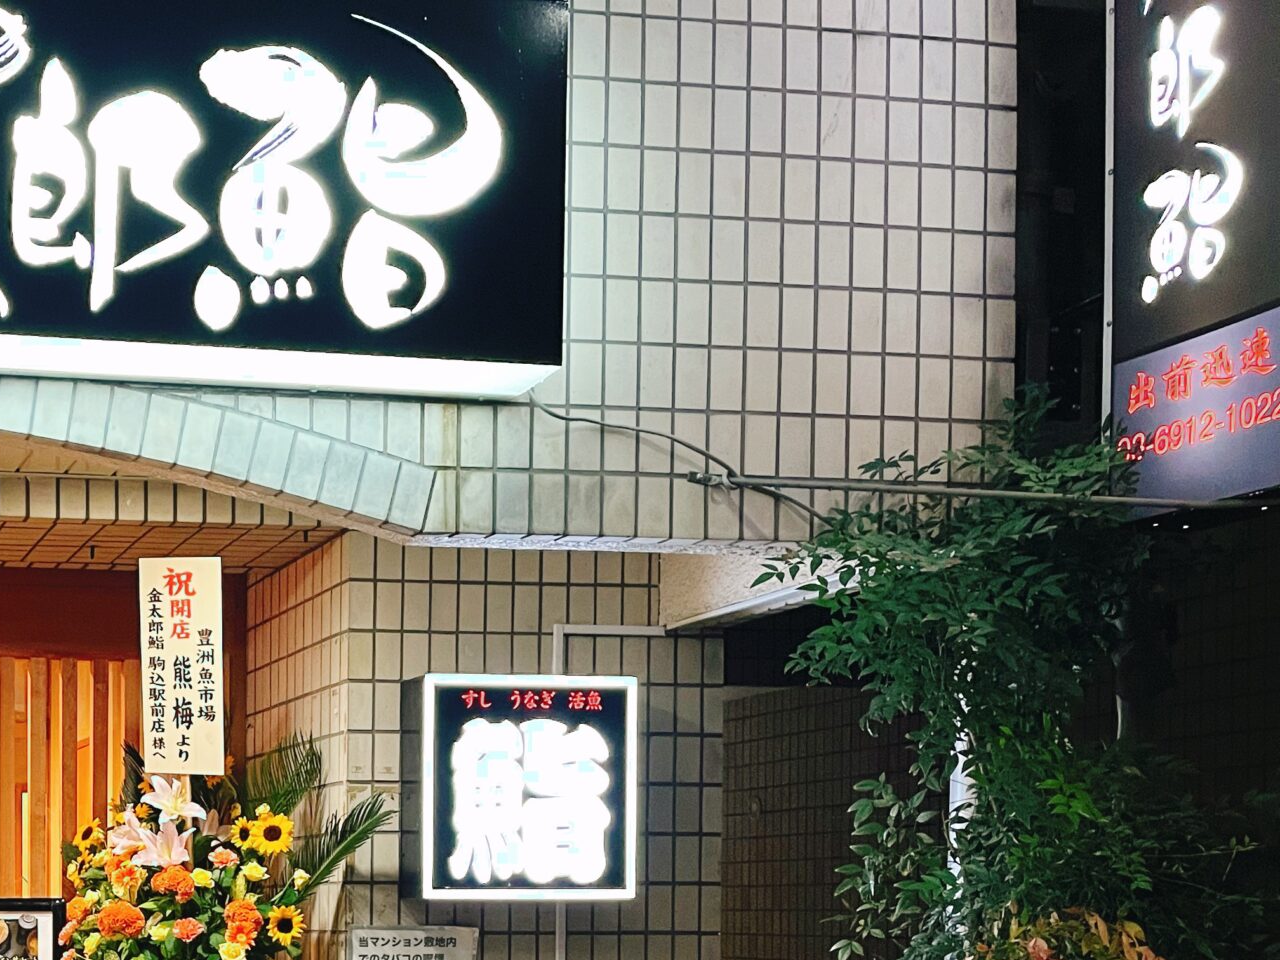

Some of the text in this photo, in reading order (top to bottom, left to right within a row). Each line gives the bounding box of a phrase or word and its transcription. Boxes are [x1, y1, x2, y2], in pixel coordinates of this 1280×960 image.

[1141, 0, 1244, 303] 郎鮨
[1127, 326, 1278, 415] 出前迅速
[162, 567, 197, 640] 祝開店
[196, 628, 216, 722] 豊洲魚市場
[461, 690, 603, 711] すし うなぎ 活魚
[358, 936, 457, 948] 当マンション敷地内
